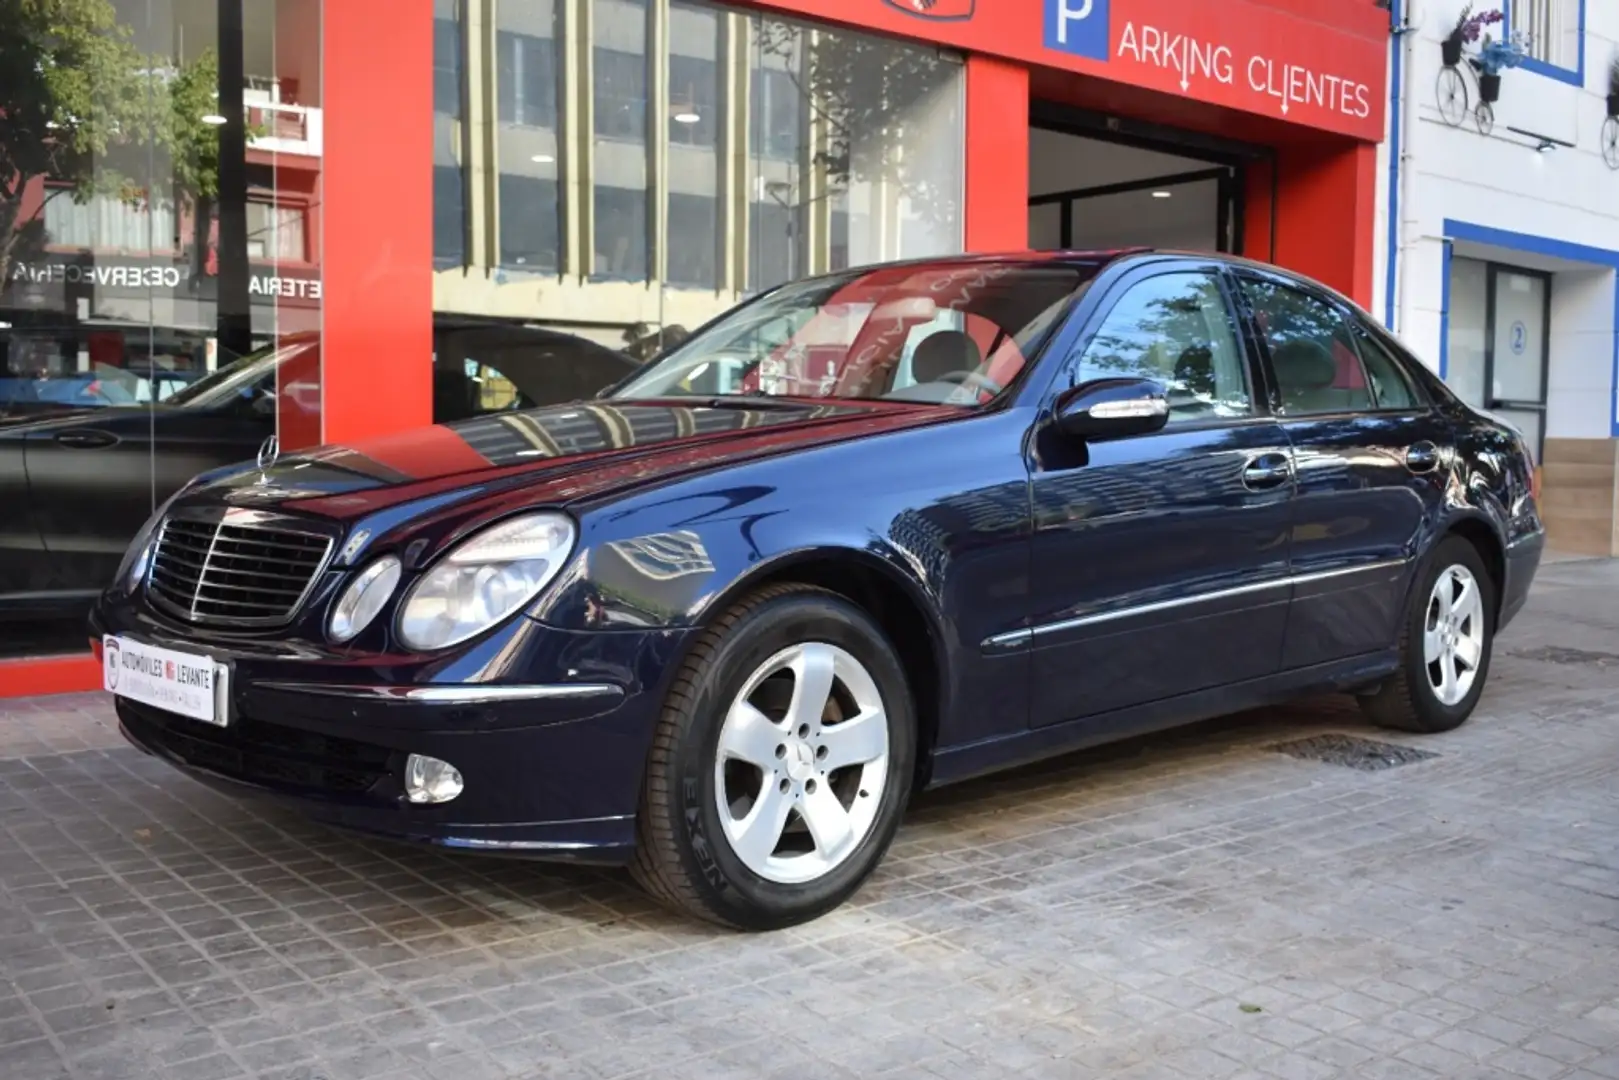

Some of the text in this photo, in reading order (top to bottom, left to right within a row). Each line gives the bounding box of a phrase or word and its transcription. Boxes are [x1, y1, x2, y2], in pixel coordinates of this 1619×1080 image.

[1057, 0, 1369, 118] P ARKING CLIENTES
[177, 663, 210, 689] LEVANTE
